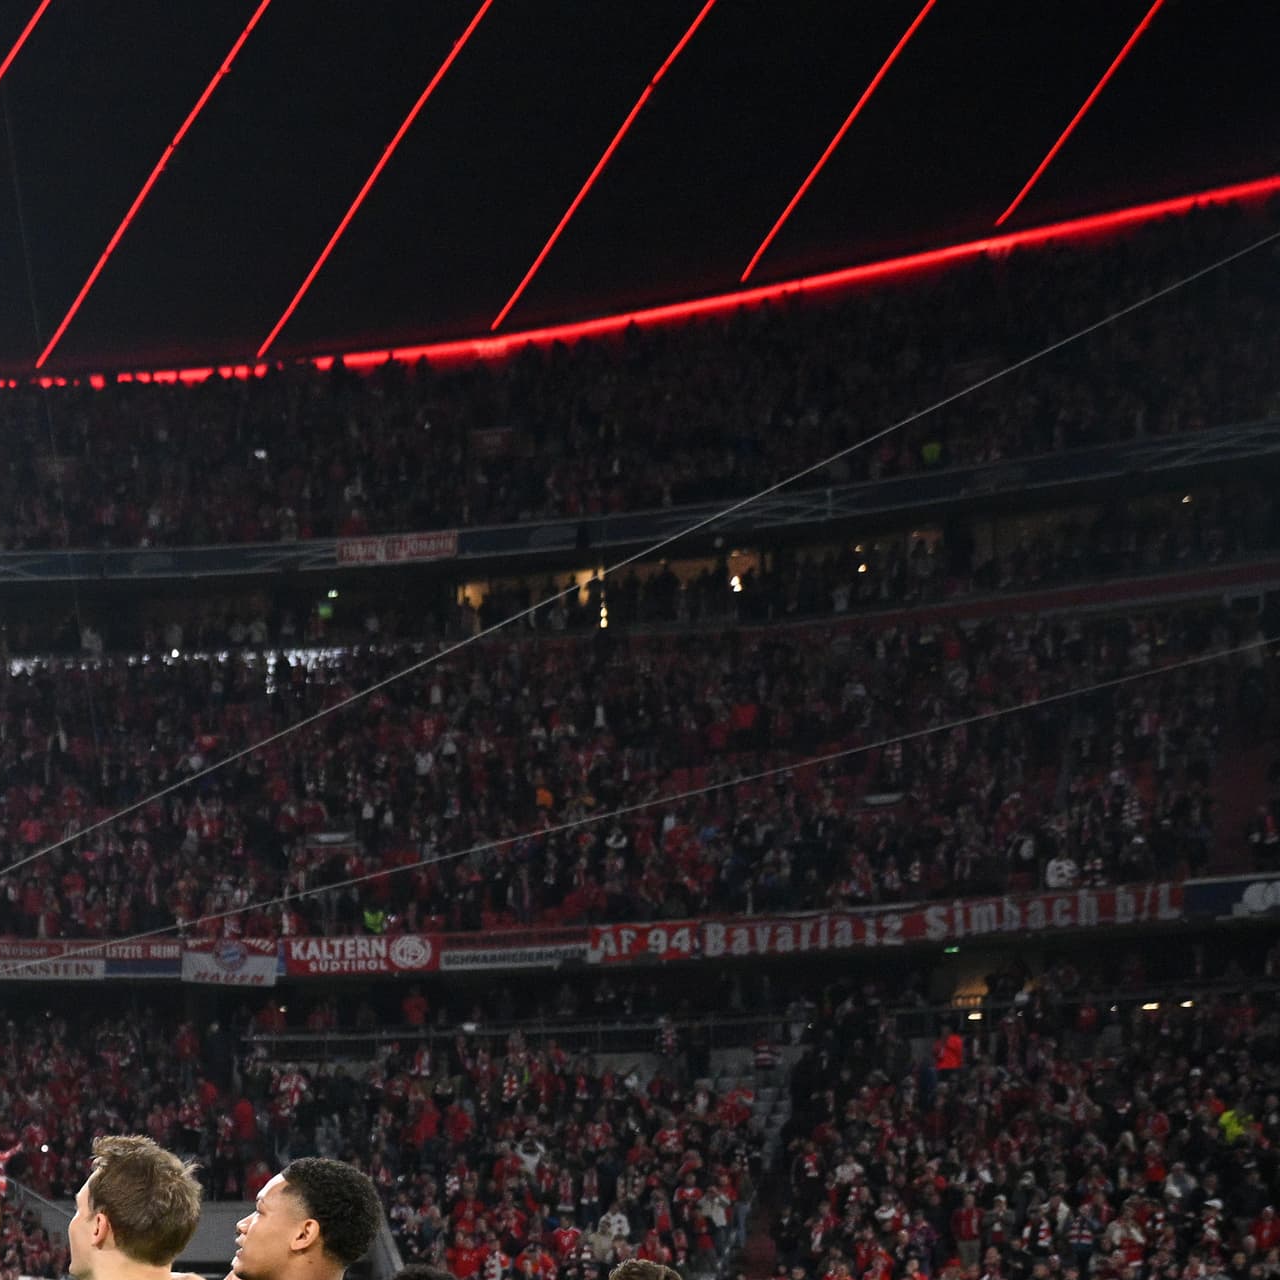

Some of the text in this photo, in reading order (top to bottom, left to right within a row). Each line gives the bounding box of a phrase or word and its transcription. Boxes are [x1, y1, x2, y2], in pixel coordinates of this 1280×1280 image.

[704, 914, 855, 957] Bavaria
[924, 889, 1098, 941] Simbach
[291, 937, 387, 960] KALTERN
[647, 927, 692, 954] 94
[309, 958, 388, 972] SÜDTIROL
